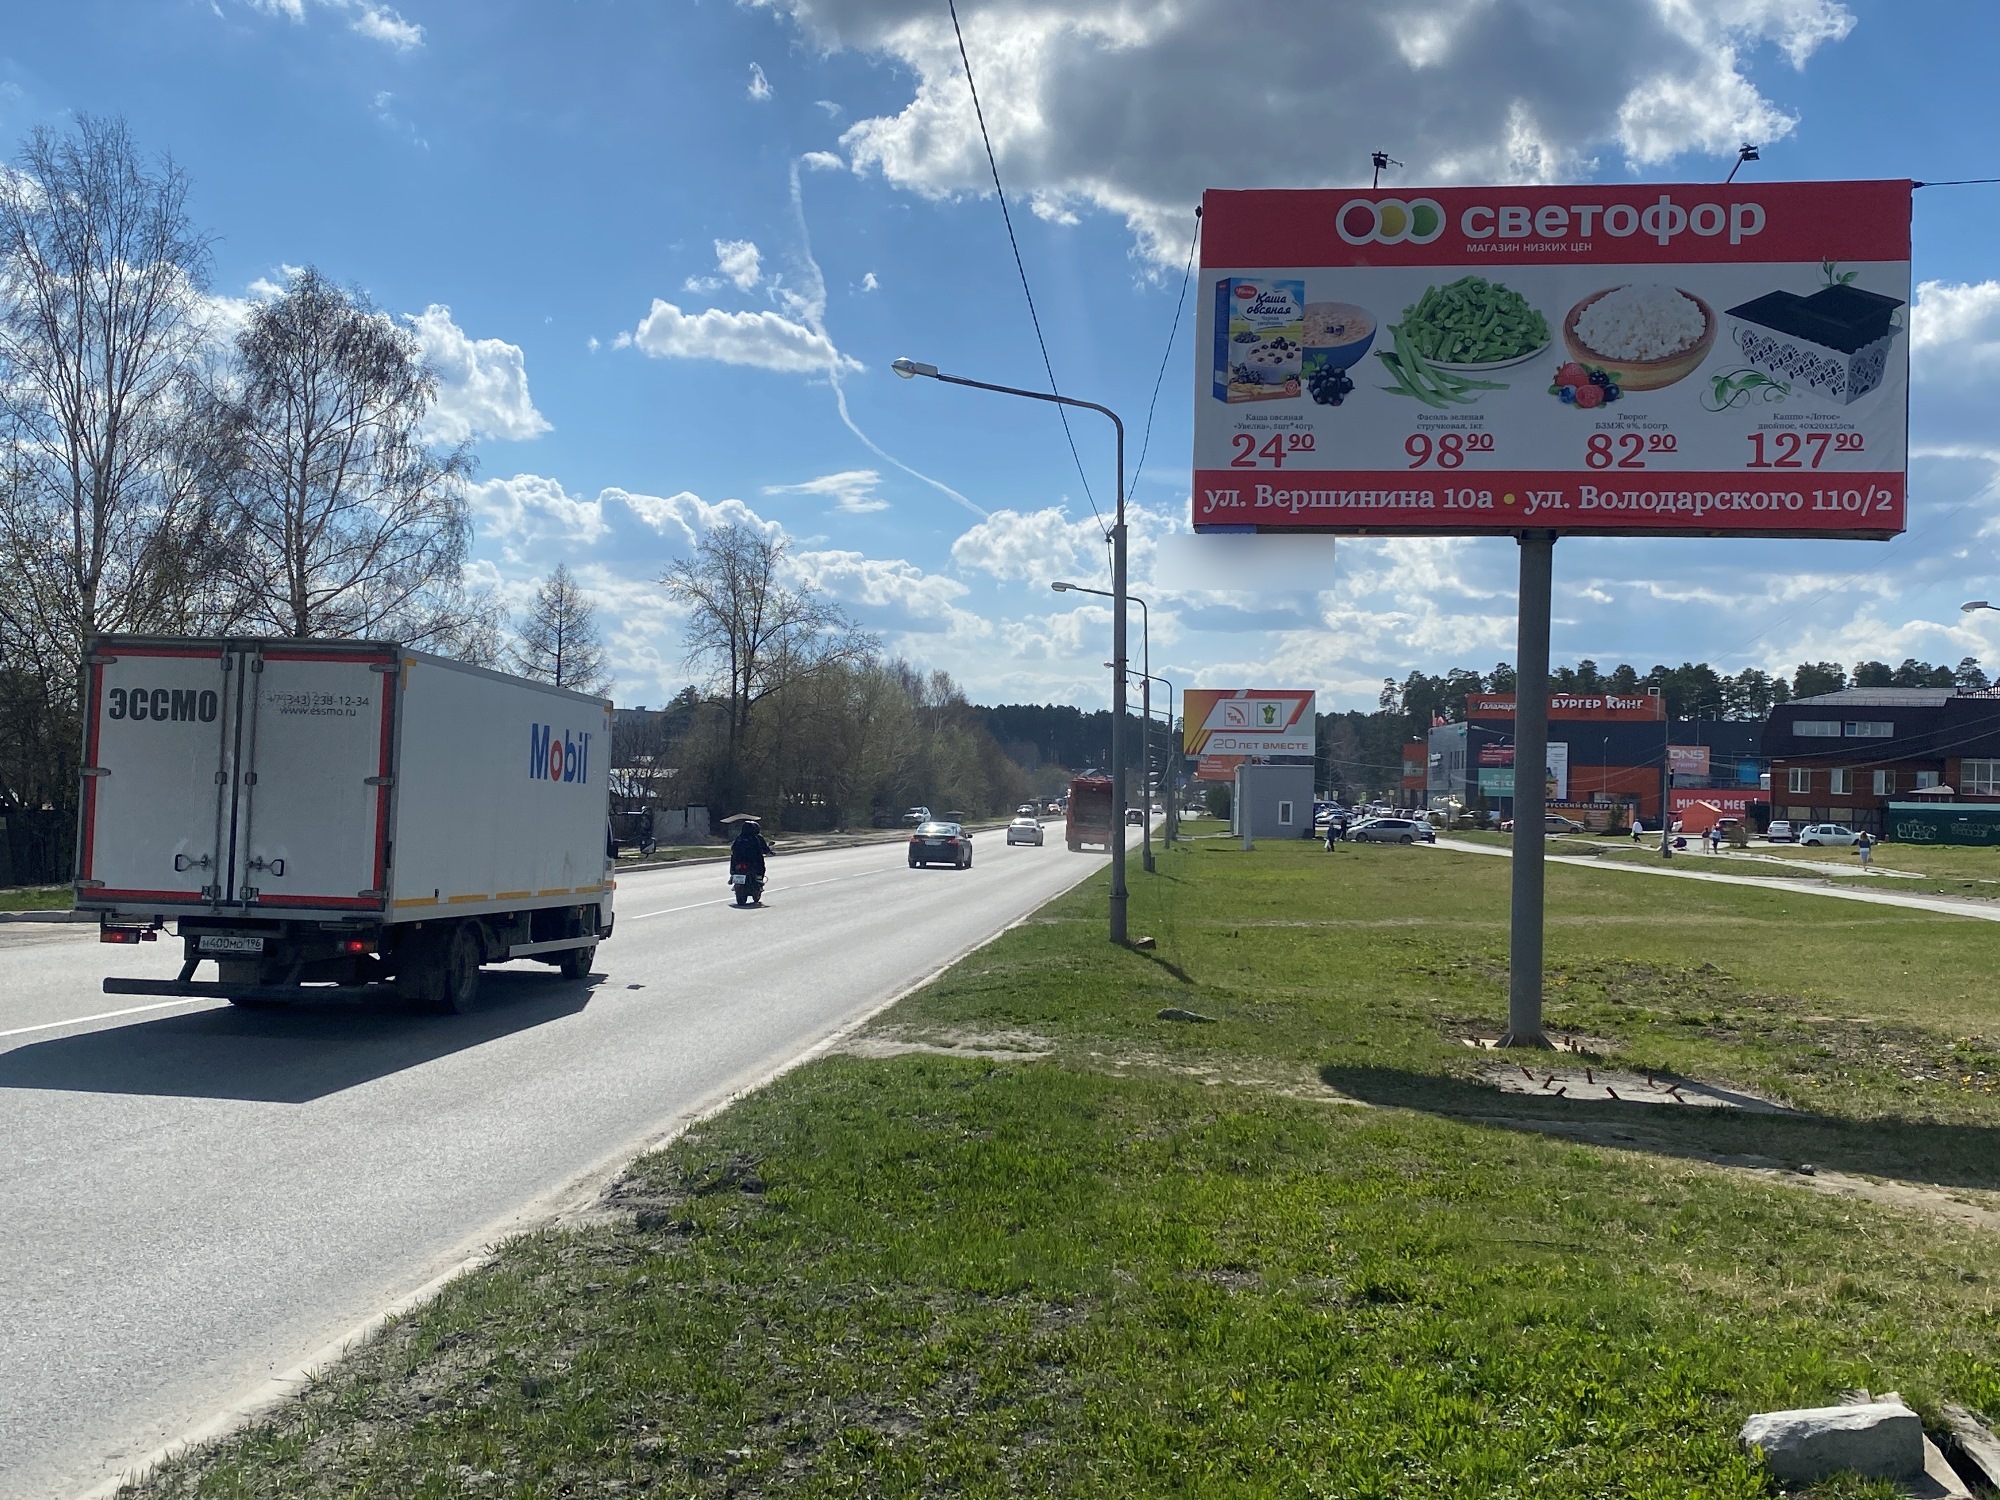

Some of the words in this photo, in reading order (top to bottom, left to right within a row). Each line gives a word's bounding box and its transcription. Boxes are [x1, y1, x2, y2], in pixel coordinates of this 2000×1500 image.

[1460, 195, 1767, 246] светофор
[1466, 243, 1520, 254] МАГАЗИН
[1523, 242, 1569, 253] НИЗКИХ
[1571, 242, 1593, 253] ЦЕН
[1255, 291, 1287, 304] Каша
[1246, 301, 1291, 315] овсяная
[1245, 413, 1268, 421] Каша
[1416, 413, 1448, 421] Фасоль
[1617, 413, 1648, 422] Творог
[1595, 422, 1624, 430] БЗМЖ
[1203, 489, 1247, 514] ул.
[1254, 484, 1436, 514] Вершинина
[1443, 487, 1494, 509] 10а
[1524, 489, 1570, 515] ул.
[1578, 485, 1804, 516] Володарского
[1811, 484, 1893, 516] 110/2
[108, 687, 218, 723] ЭССМО
[1551, 698, 1602, 709] БУРГЕР
[1606, 698, 1644, 710] КИНГ
[279, 706, 357, 717] www.essmo.ru
[1213, 738, 1237, 749] 20
[1238, 742, 1260, 750] ЛЕТ
[1262, 742, 1309, 750] ВМЕСТЕ
[529, 723, 589, 784] Mobil
[1669, 748, 1705, 760] DNS
